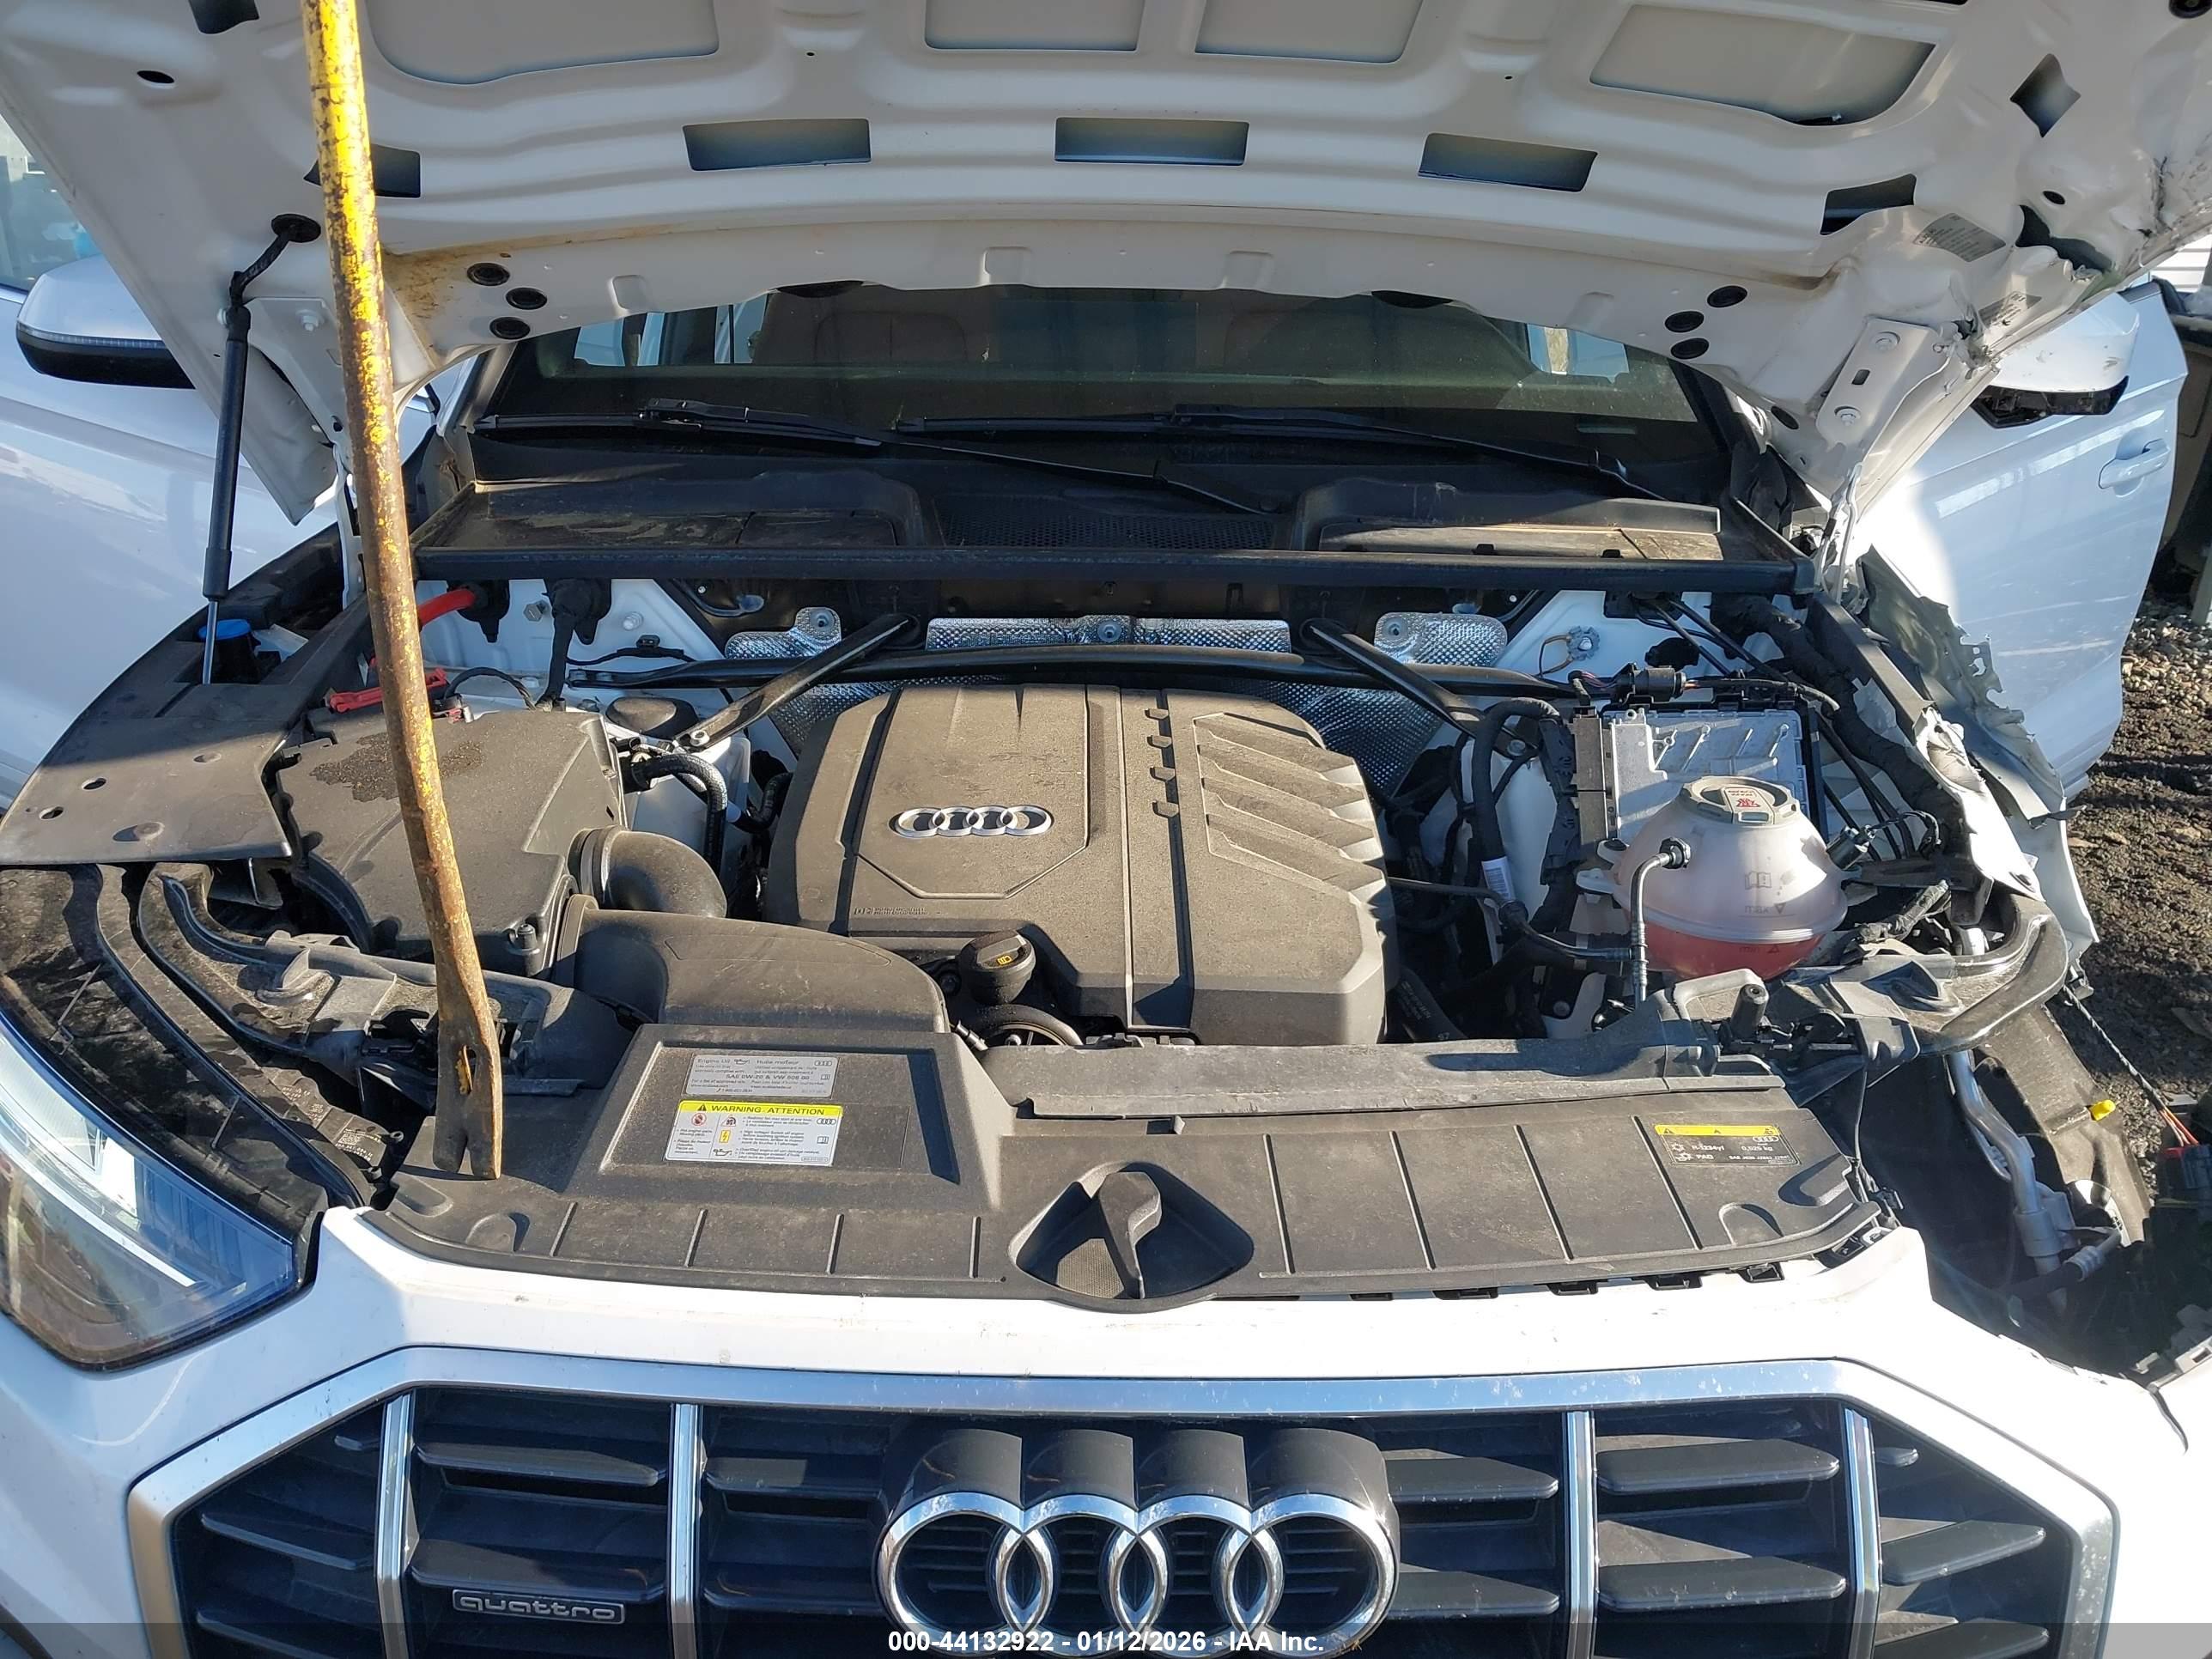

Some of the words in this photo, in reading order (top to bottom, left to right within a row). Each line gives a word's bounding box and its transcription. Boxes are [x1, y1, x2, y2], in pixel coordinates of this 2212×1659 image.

[1744, 904, 1770, 915] max
[711, 1105, 763, 1114] WARNING
[766, 1107, 825, 1115] ATTENTION
[459, 1596, 616, 1620] quattro
